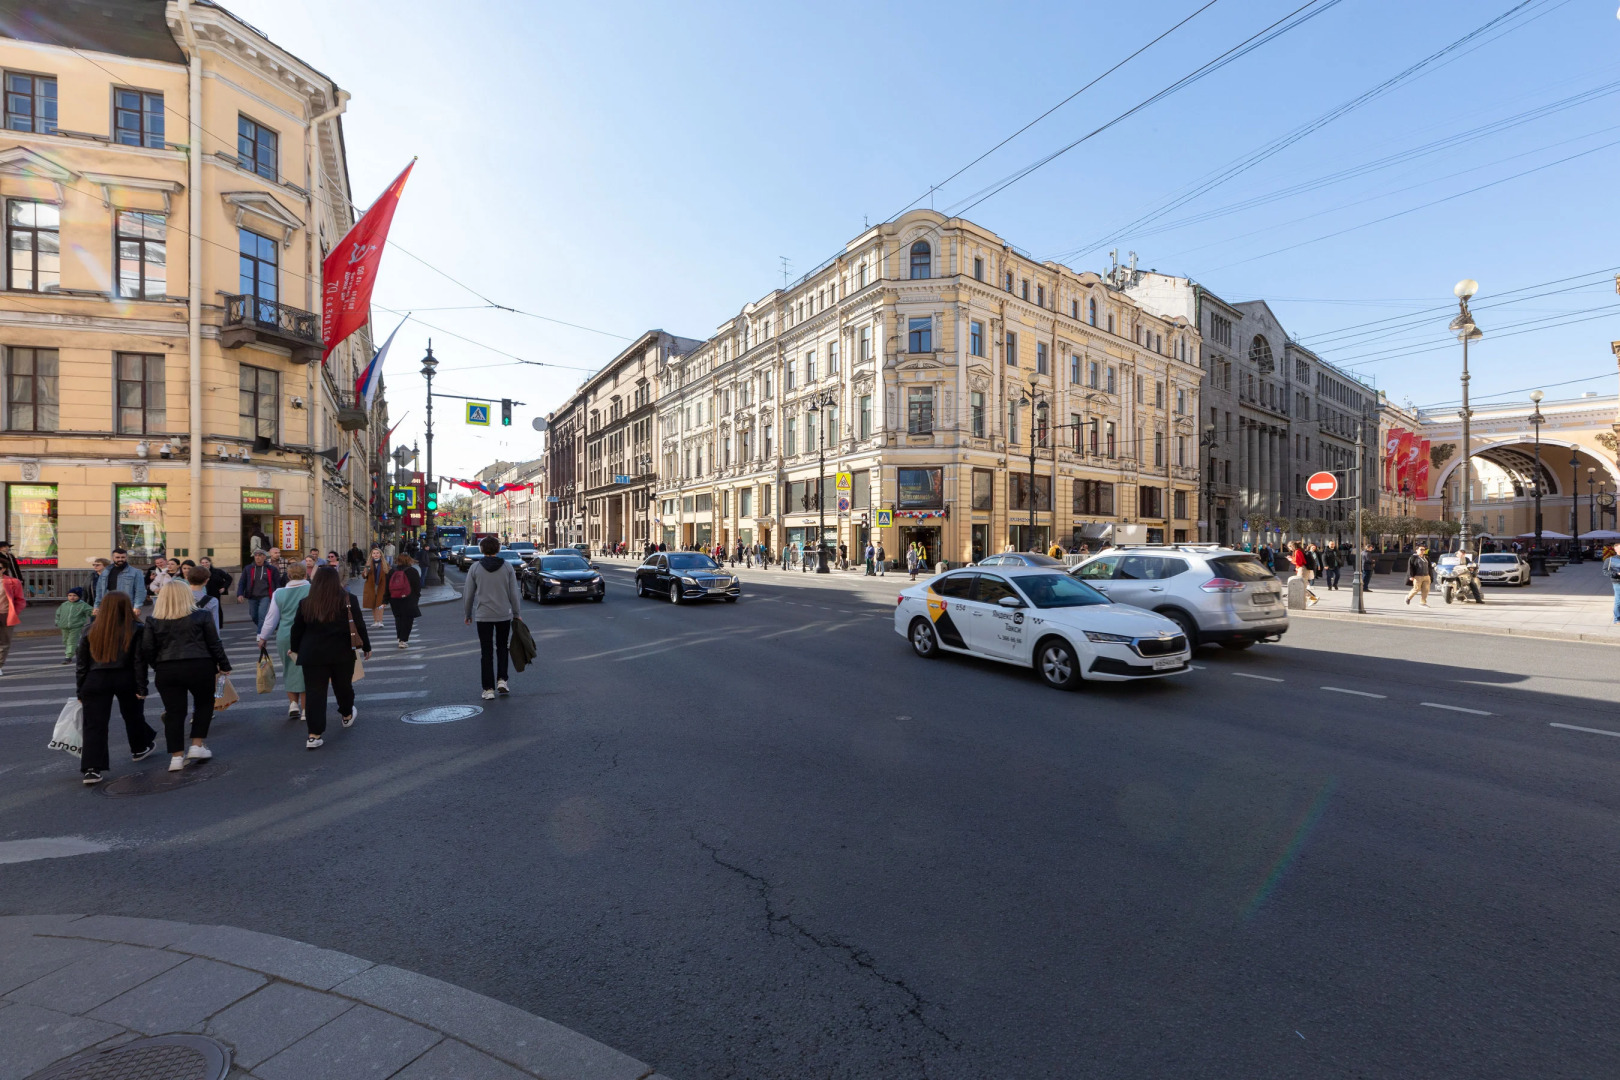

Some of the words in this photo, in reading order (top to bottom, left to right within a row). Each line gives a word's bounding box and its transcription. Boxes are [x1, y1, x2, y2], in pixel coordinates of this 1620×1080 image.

[1387, 439, 1399, 453] 9
[1409, 447, 1419, 461] 9
[395, 492, 406, 501] 43
[992, 610, 1012, 620] Яндекс
[1015, 614, 1023, 622] Go
[1005, 623, 1022, 633] Такси
